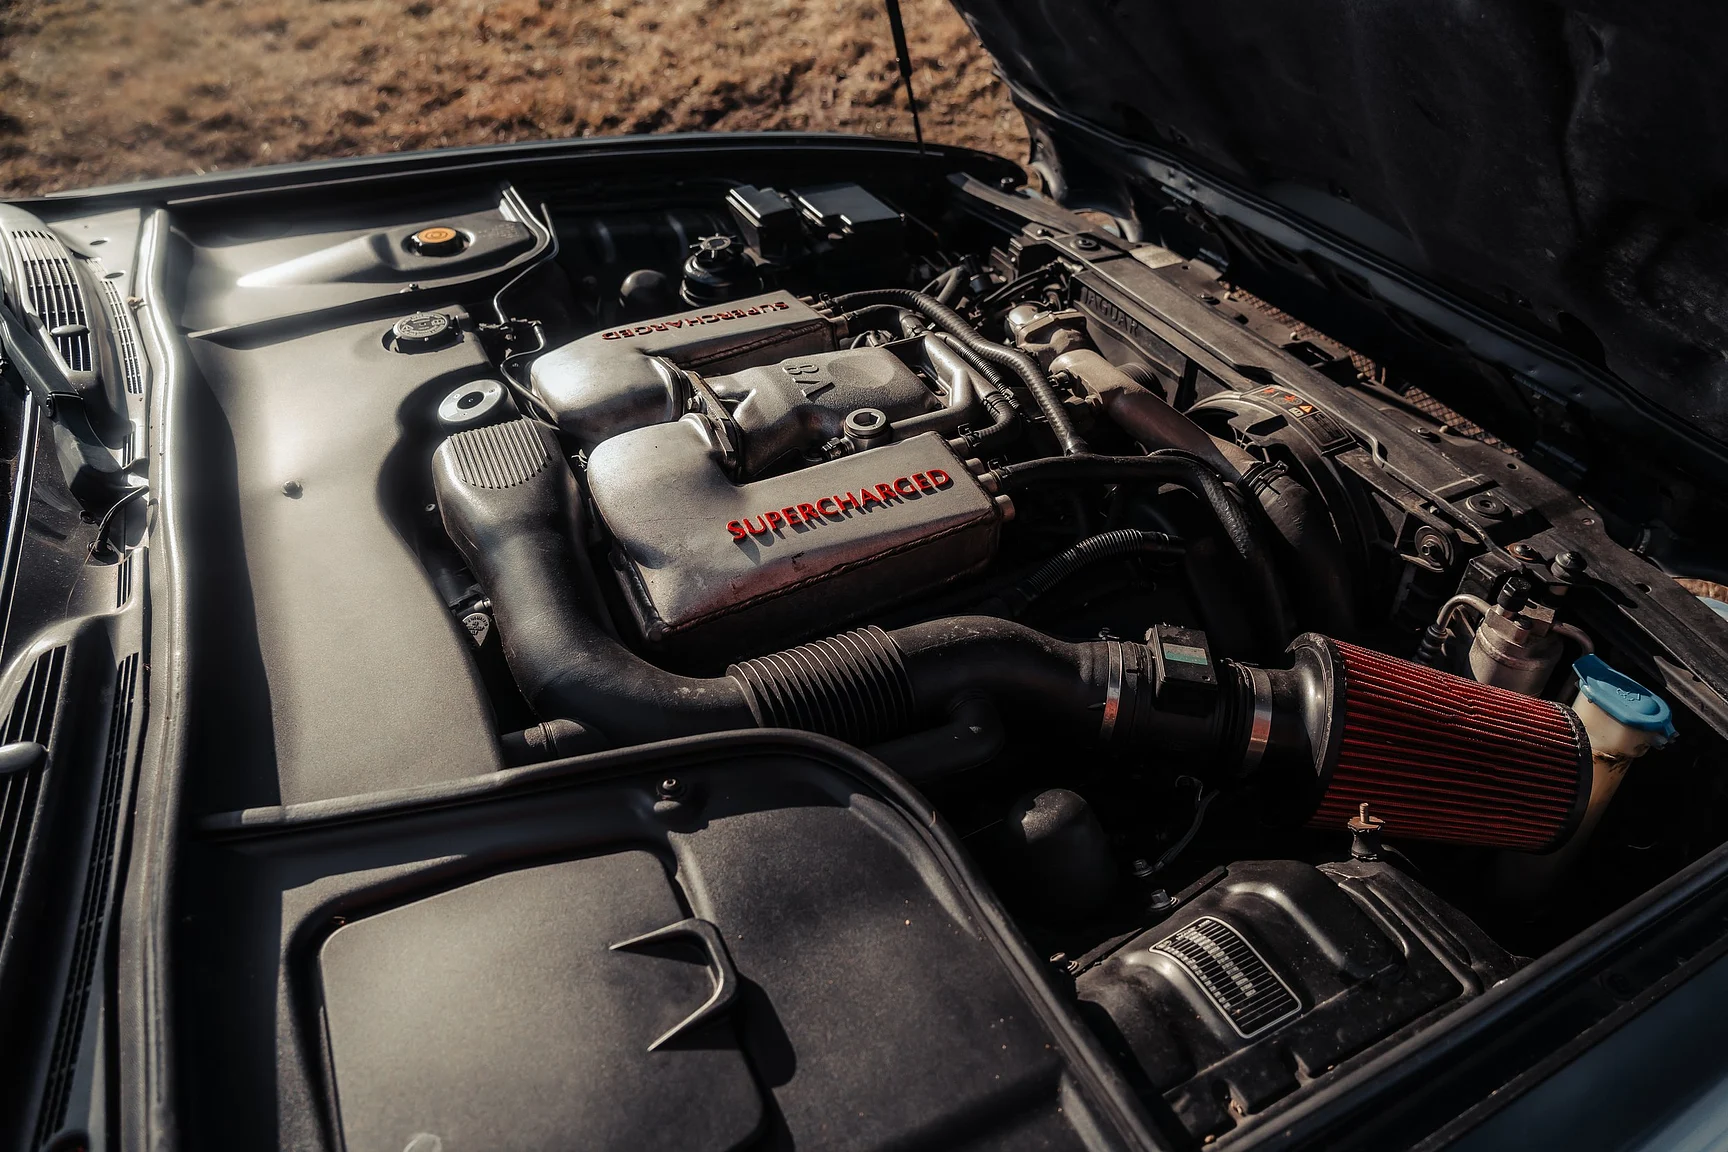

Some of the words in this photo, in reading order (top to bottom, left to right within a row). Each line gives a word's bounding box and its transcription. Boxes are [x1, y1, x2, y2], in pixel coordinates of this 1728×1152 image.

[601, 301, 790, 340] SUPERCHARGED
[1080, 285, 1138, 338] JAGUAR
[782, 363, 836, 403] V8
[726, 469, 951, 542] SUPERCHARGED
